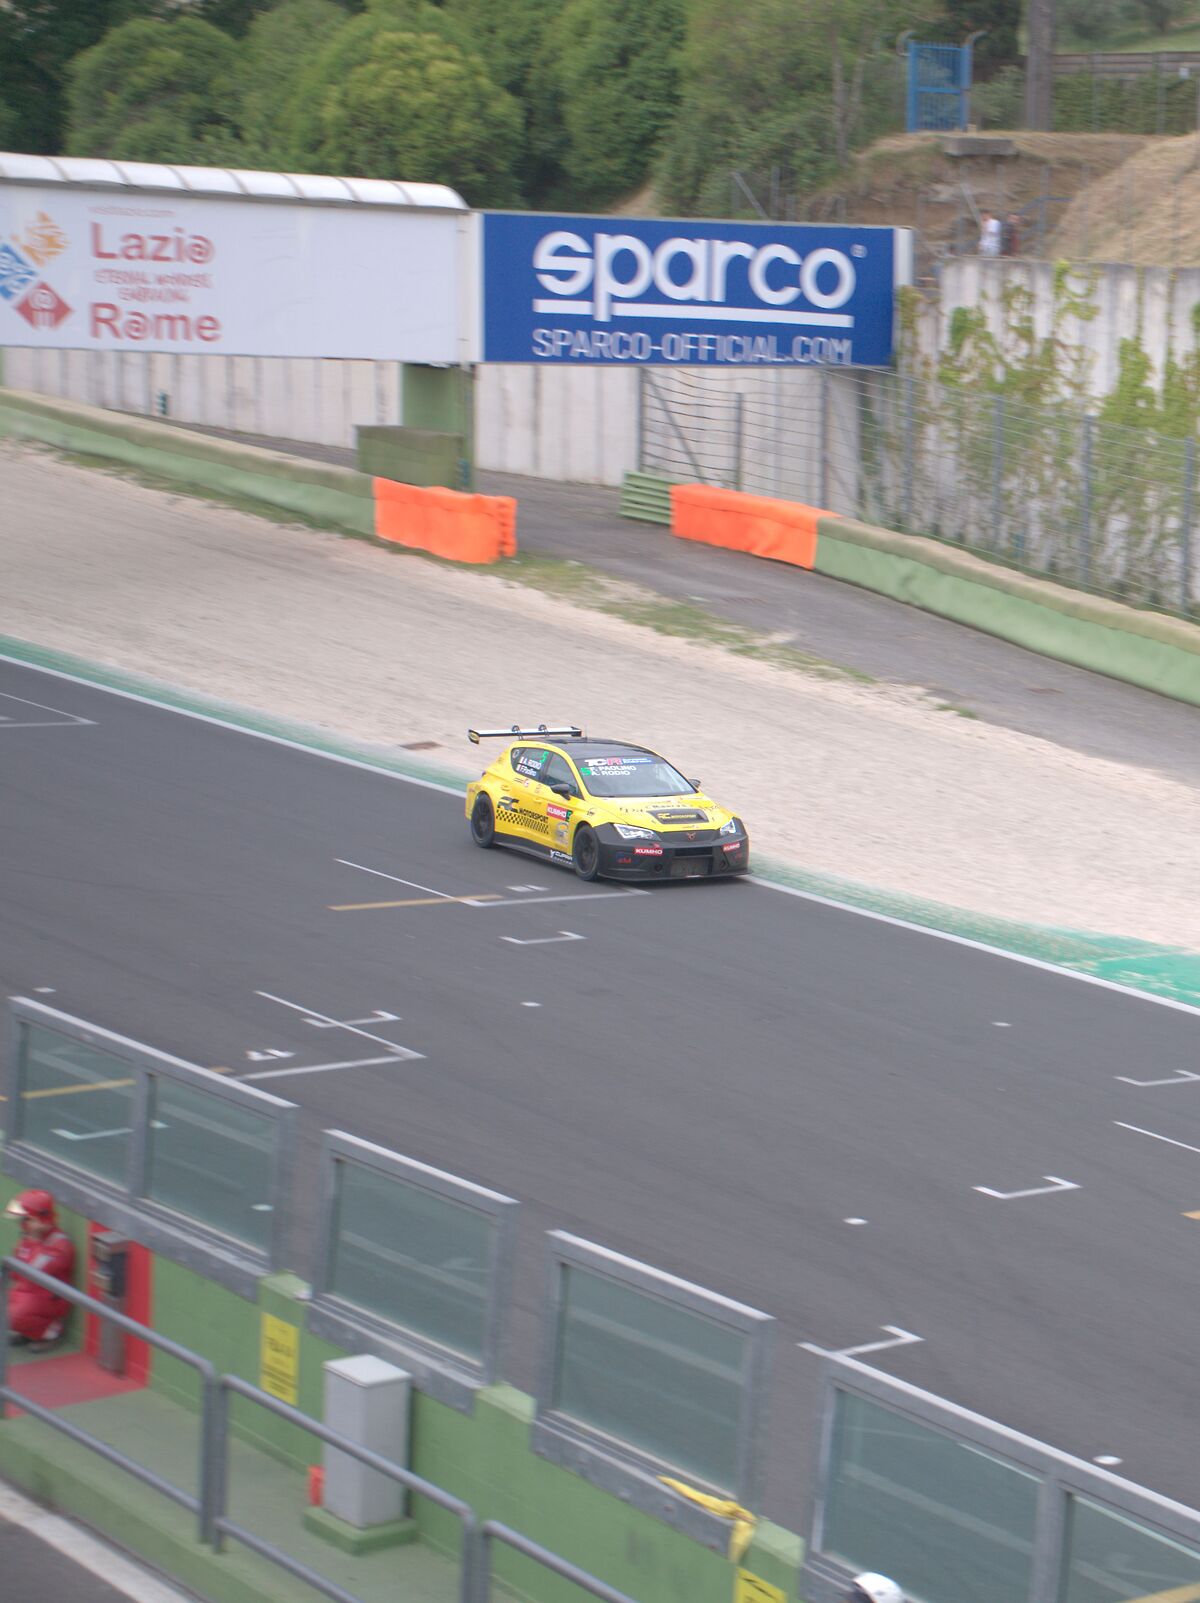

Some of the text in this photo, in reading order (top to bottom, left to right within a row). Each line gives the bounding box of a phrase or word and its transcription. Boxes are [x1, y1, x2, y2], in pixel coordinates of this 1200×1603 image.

[533, 230, 857, 322] sparco
[532, 328, 853, 365] SPARCO-OFFICIAL.COM
[584, 757, 621, 766] TCR
